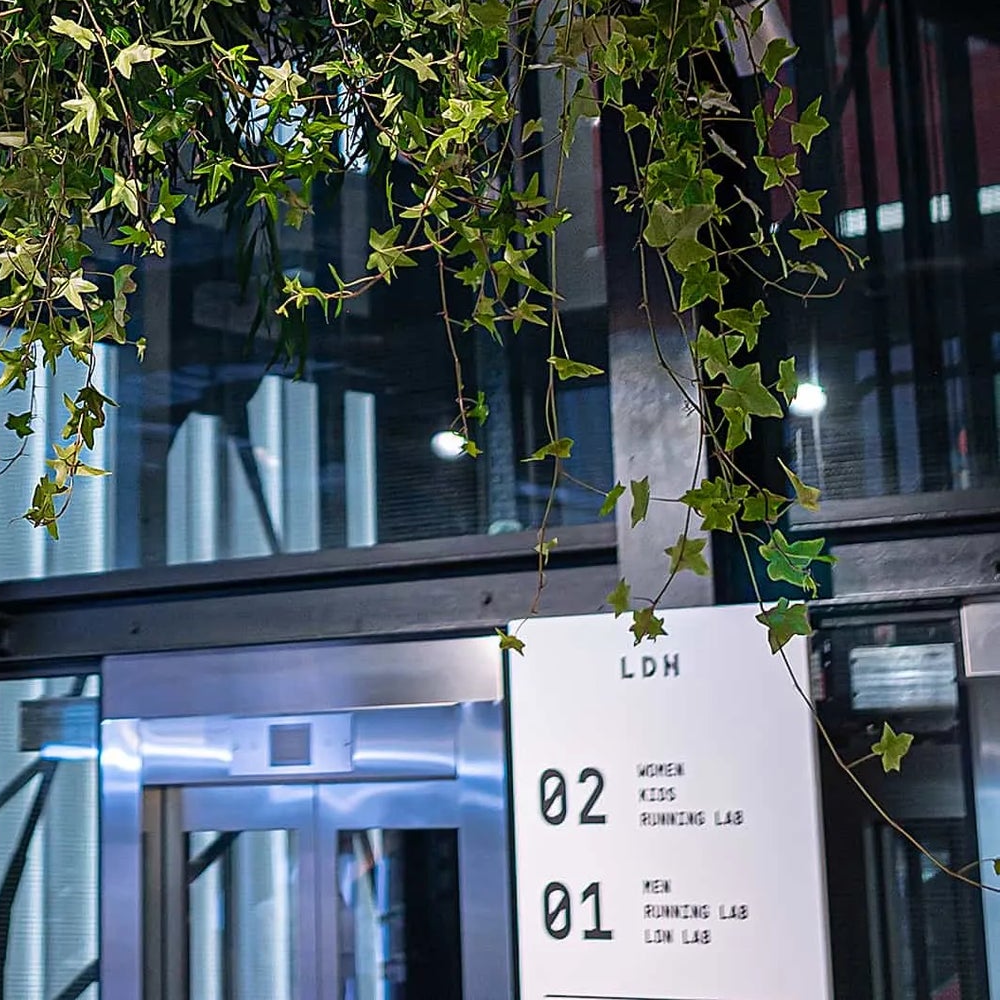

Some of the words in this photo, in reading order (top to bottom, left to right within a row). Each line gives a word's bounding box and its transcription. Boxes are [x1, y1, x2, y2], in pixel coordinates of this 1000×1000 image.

[636, 762, 686, 779] WOMEN
[537, 766, 609, 827] 02
[638, 786, 677, 803] KIDS
[639, 810, 706, 827] RUNNING
[713, 809, 745, 826] LAB
[642, 879, 672, 895] MEN
[541, 880, 615, 941] 01
[643, 903, 711, 920] RUNNING
[718, 903, 750, 920] LAB
[681, 928, 712, 945] LAB
